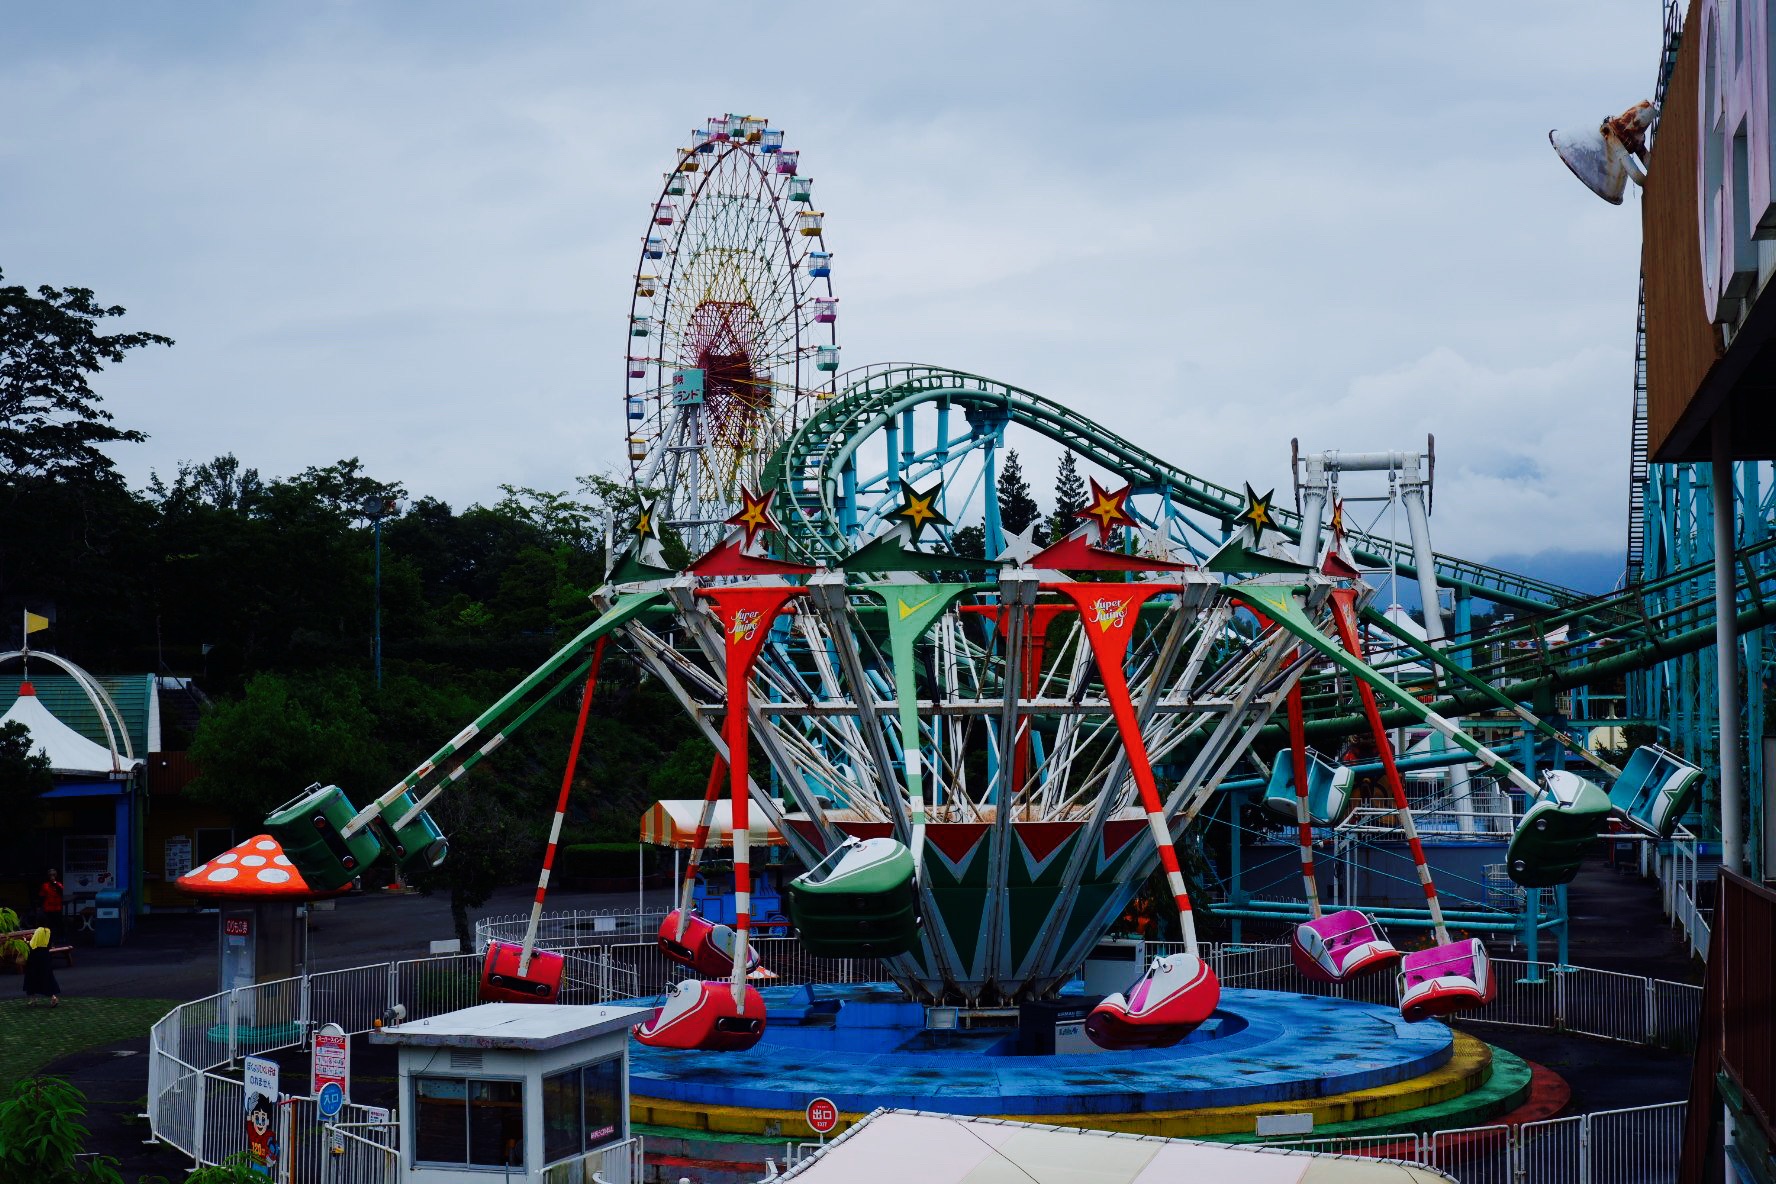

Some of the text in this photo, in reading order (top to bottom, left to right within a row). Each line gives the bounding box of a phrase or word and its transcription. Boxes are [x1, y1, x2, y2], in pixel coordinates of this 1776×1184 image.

[1089, 598, 1122, 611] Super
[730, 608, 759, 621] Super
[1088, 609, 1128, 628] Swing
[323, 1093, 339, 1106] 入口
[812, 1108, 832, 1120] 出口
